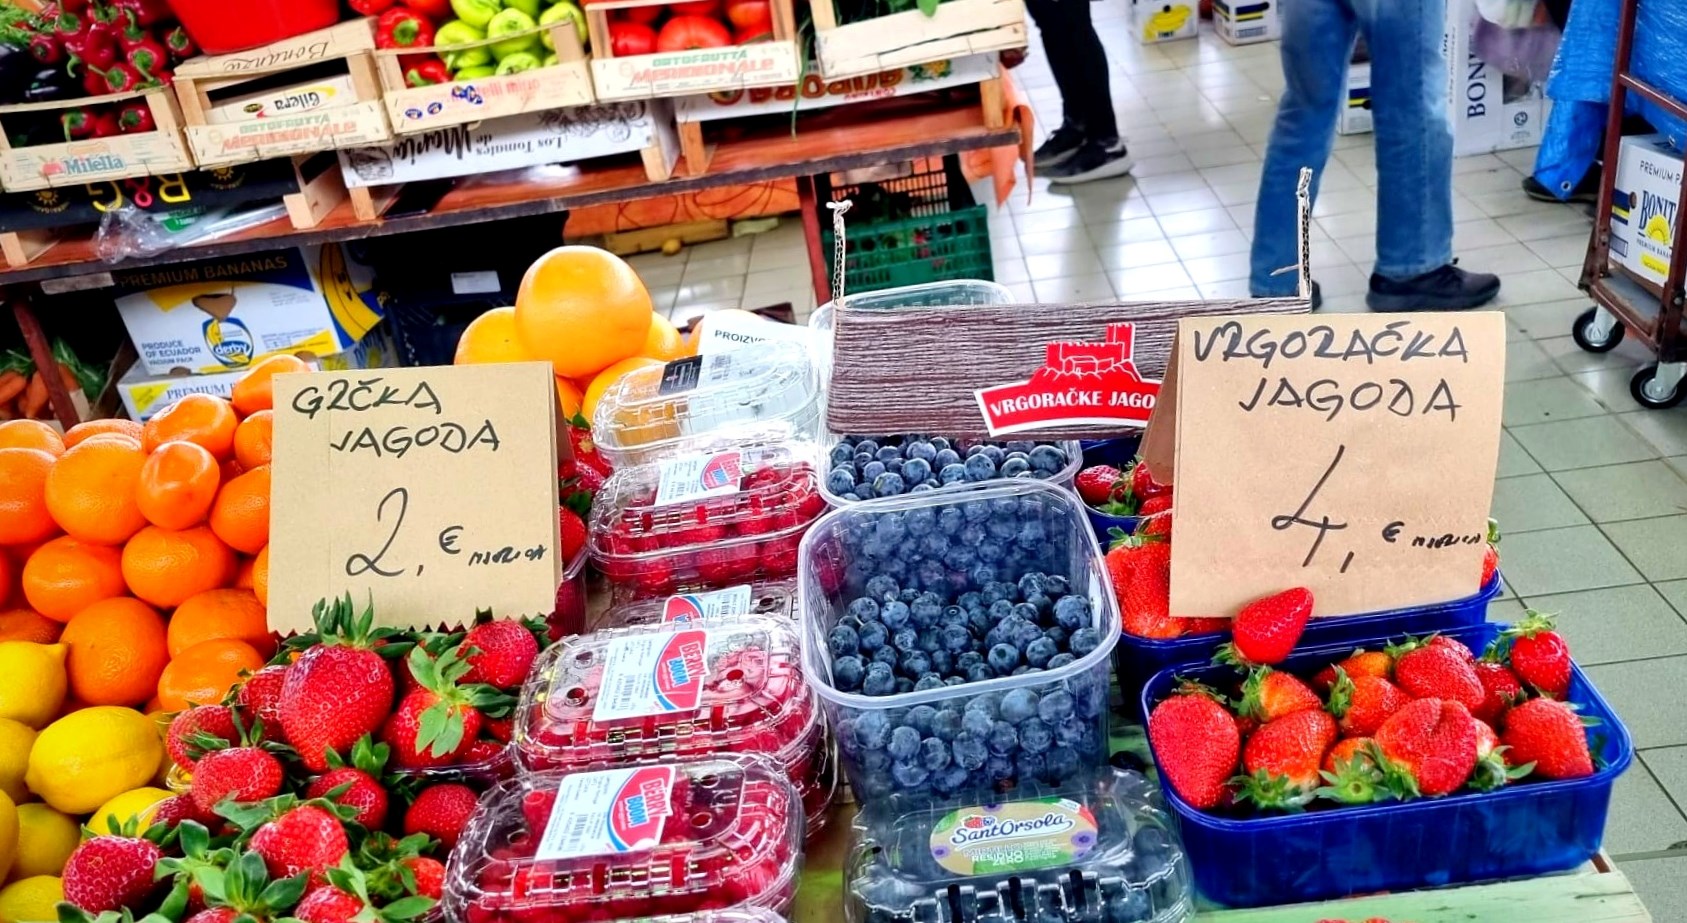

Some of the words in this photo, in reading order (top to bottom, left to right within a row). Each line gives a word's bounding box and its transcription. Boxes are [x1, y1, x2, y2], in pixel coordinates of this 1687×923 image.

[273, 92, 320, 111] Gilera
[475, 133, 493, 145] de
[475, 139, 533, 157] Tomates
[537, 136, 563, 150] Los
[64, 155, 125, 175] Milella
[1640, 160, 1674, 183] PREMIUM
[119, 266, 199, 288] PREMIUM
[204, 255, 288, 279] BANANAS
[141, 341, 183, 350] PRODUCE
[158, 347, 201, 356] ECUADOR
[214, 341, 249, 356] derby
[1194, 321, 1469, 368] VRGORAČKA
[989, 388, 1104, 416] VRGORAČKE
[1239, 377, 1462, 421] JAGODA
[330, 420, 500, 458] JAGODA
[669, 658, 689, 686] BOOM
[680, 643, 705, 681] BERRY
[641, 778, 669, 817] BERRY
[627, 796, 647, 827] BOOM
[992, 856, 1024, 866] ZERO
